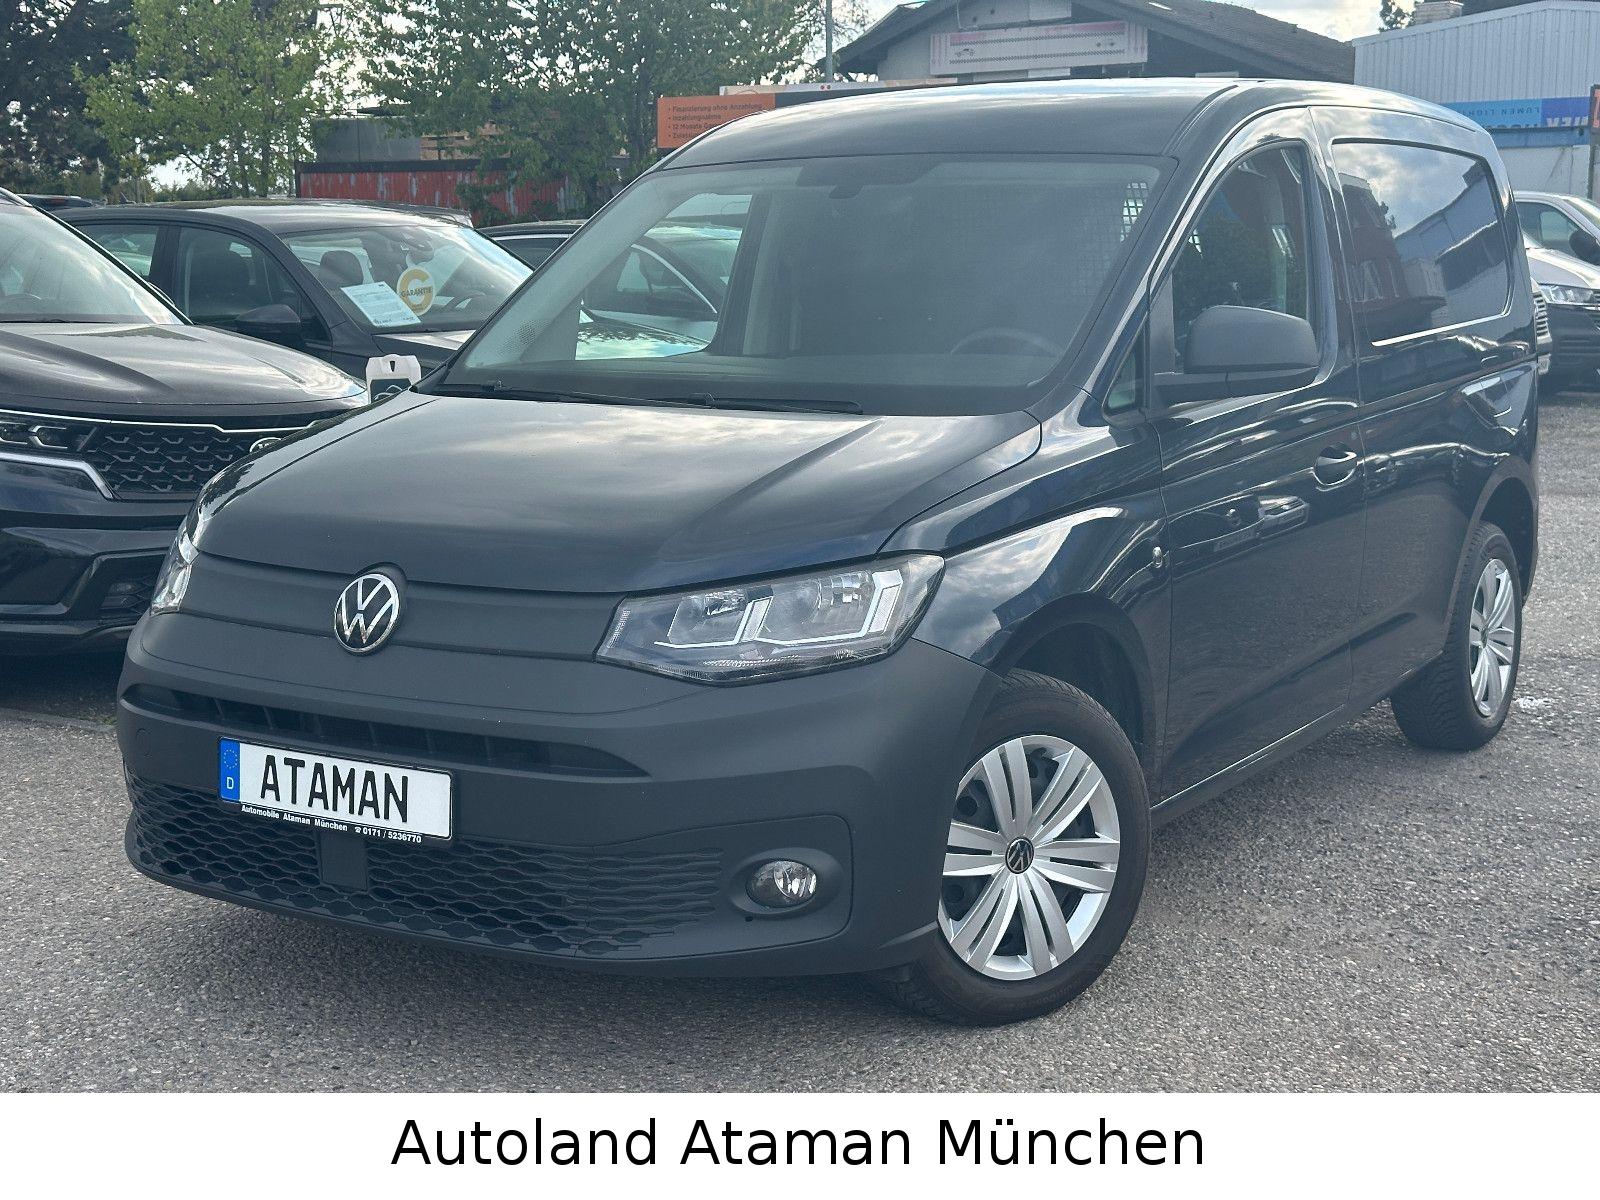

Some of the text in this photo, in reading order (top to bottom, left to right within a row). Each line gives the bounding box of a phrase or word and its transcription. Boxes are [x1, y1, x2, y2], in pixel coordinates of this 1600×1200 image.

[226, 776, 235, 790] D
[260, 754, 409, 823] ATAMAN
[241, 804, 280, 819] Automobile
[283, 812, 311, 825] Ataman
[314, 818, 348, 831] München
[362, 826, 381, 837] 0171
[387, 831, 422, 843] 5236770
